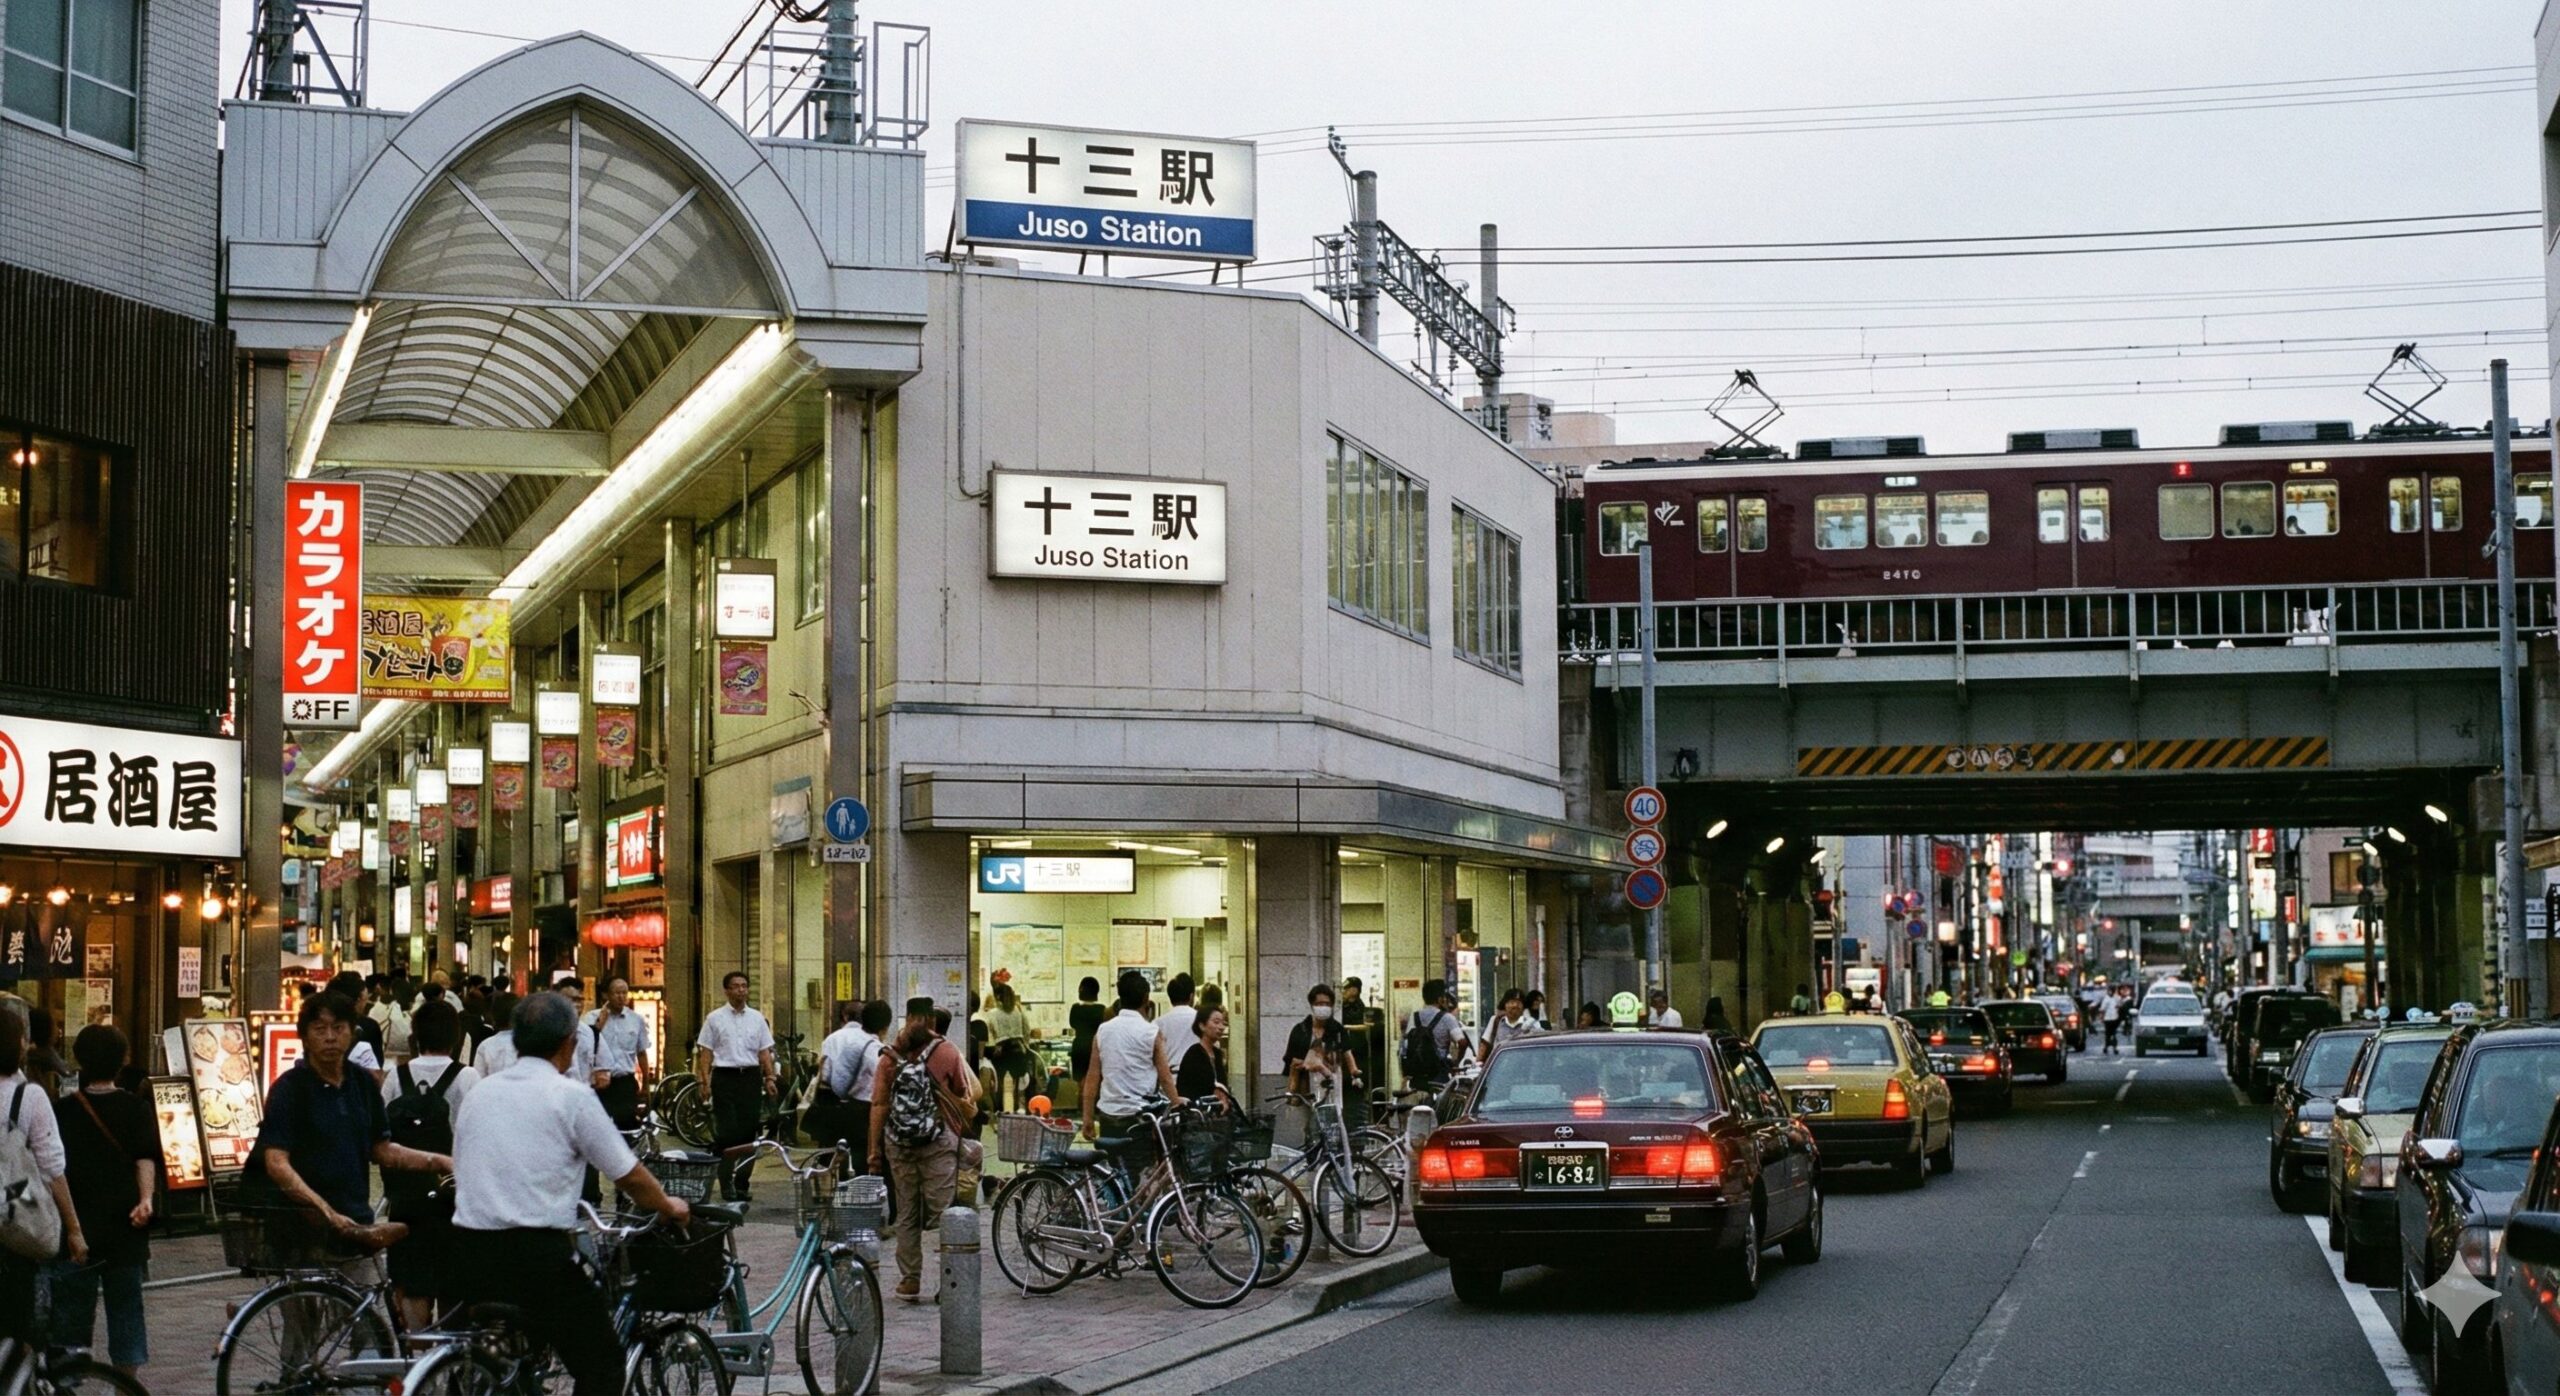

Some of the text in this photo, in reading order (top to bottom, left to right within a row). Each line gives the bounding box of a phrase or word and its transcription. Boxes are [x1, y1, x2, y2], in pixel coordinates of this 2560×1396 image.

[1005, 137, 1215, 207] 十三駅
[1018, 211, 1201, 246] Juso Station
[1024, 486, 1199, 540] 十三駅
[1035, 544, 1189, 570] Juso Station
[296, 490, 346, 687] カラオケ
[44, 748, 218, 832] 居酒屋
[1633, 797, 1658, 817] 40
[986, 862, 1022, 885] JR
[1033, 861, 1081, 877] 十三駅
